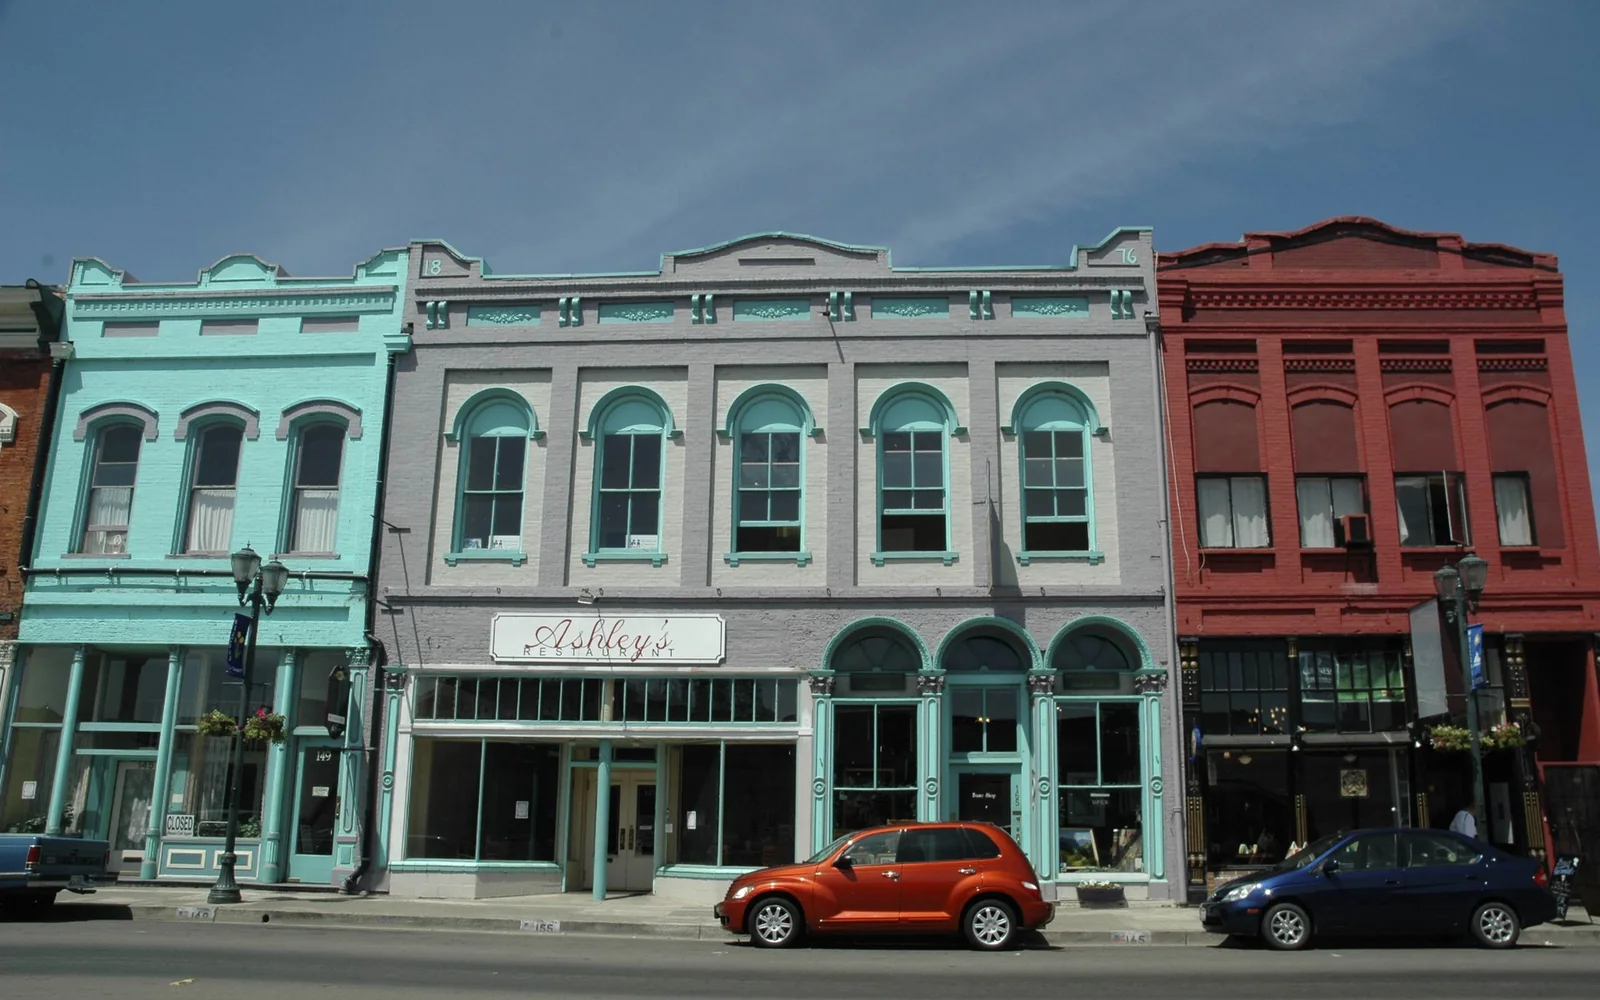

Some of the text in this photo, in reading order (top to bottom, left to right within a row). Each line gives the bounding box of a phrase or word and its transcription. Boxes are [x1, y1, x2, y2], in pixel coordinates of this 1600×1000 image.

[1115, 247, 1137, 264] 76
[424, 259, 442, 276] 18
[524, 618, 674, 662] Ashley's
[523, 647, 675, 658] RESTAURANT
[316, 750, 332, 762] 149
[167, 815, 193, 831] CLOSED
